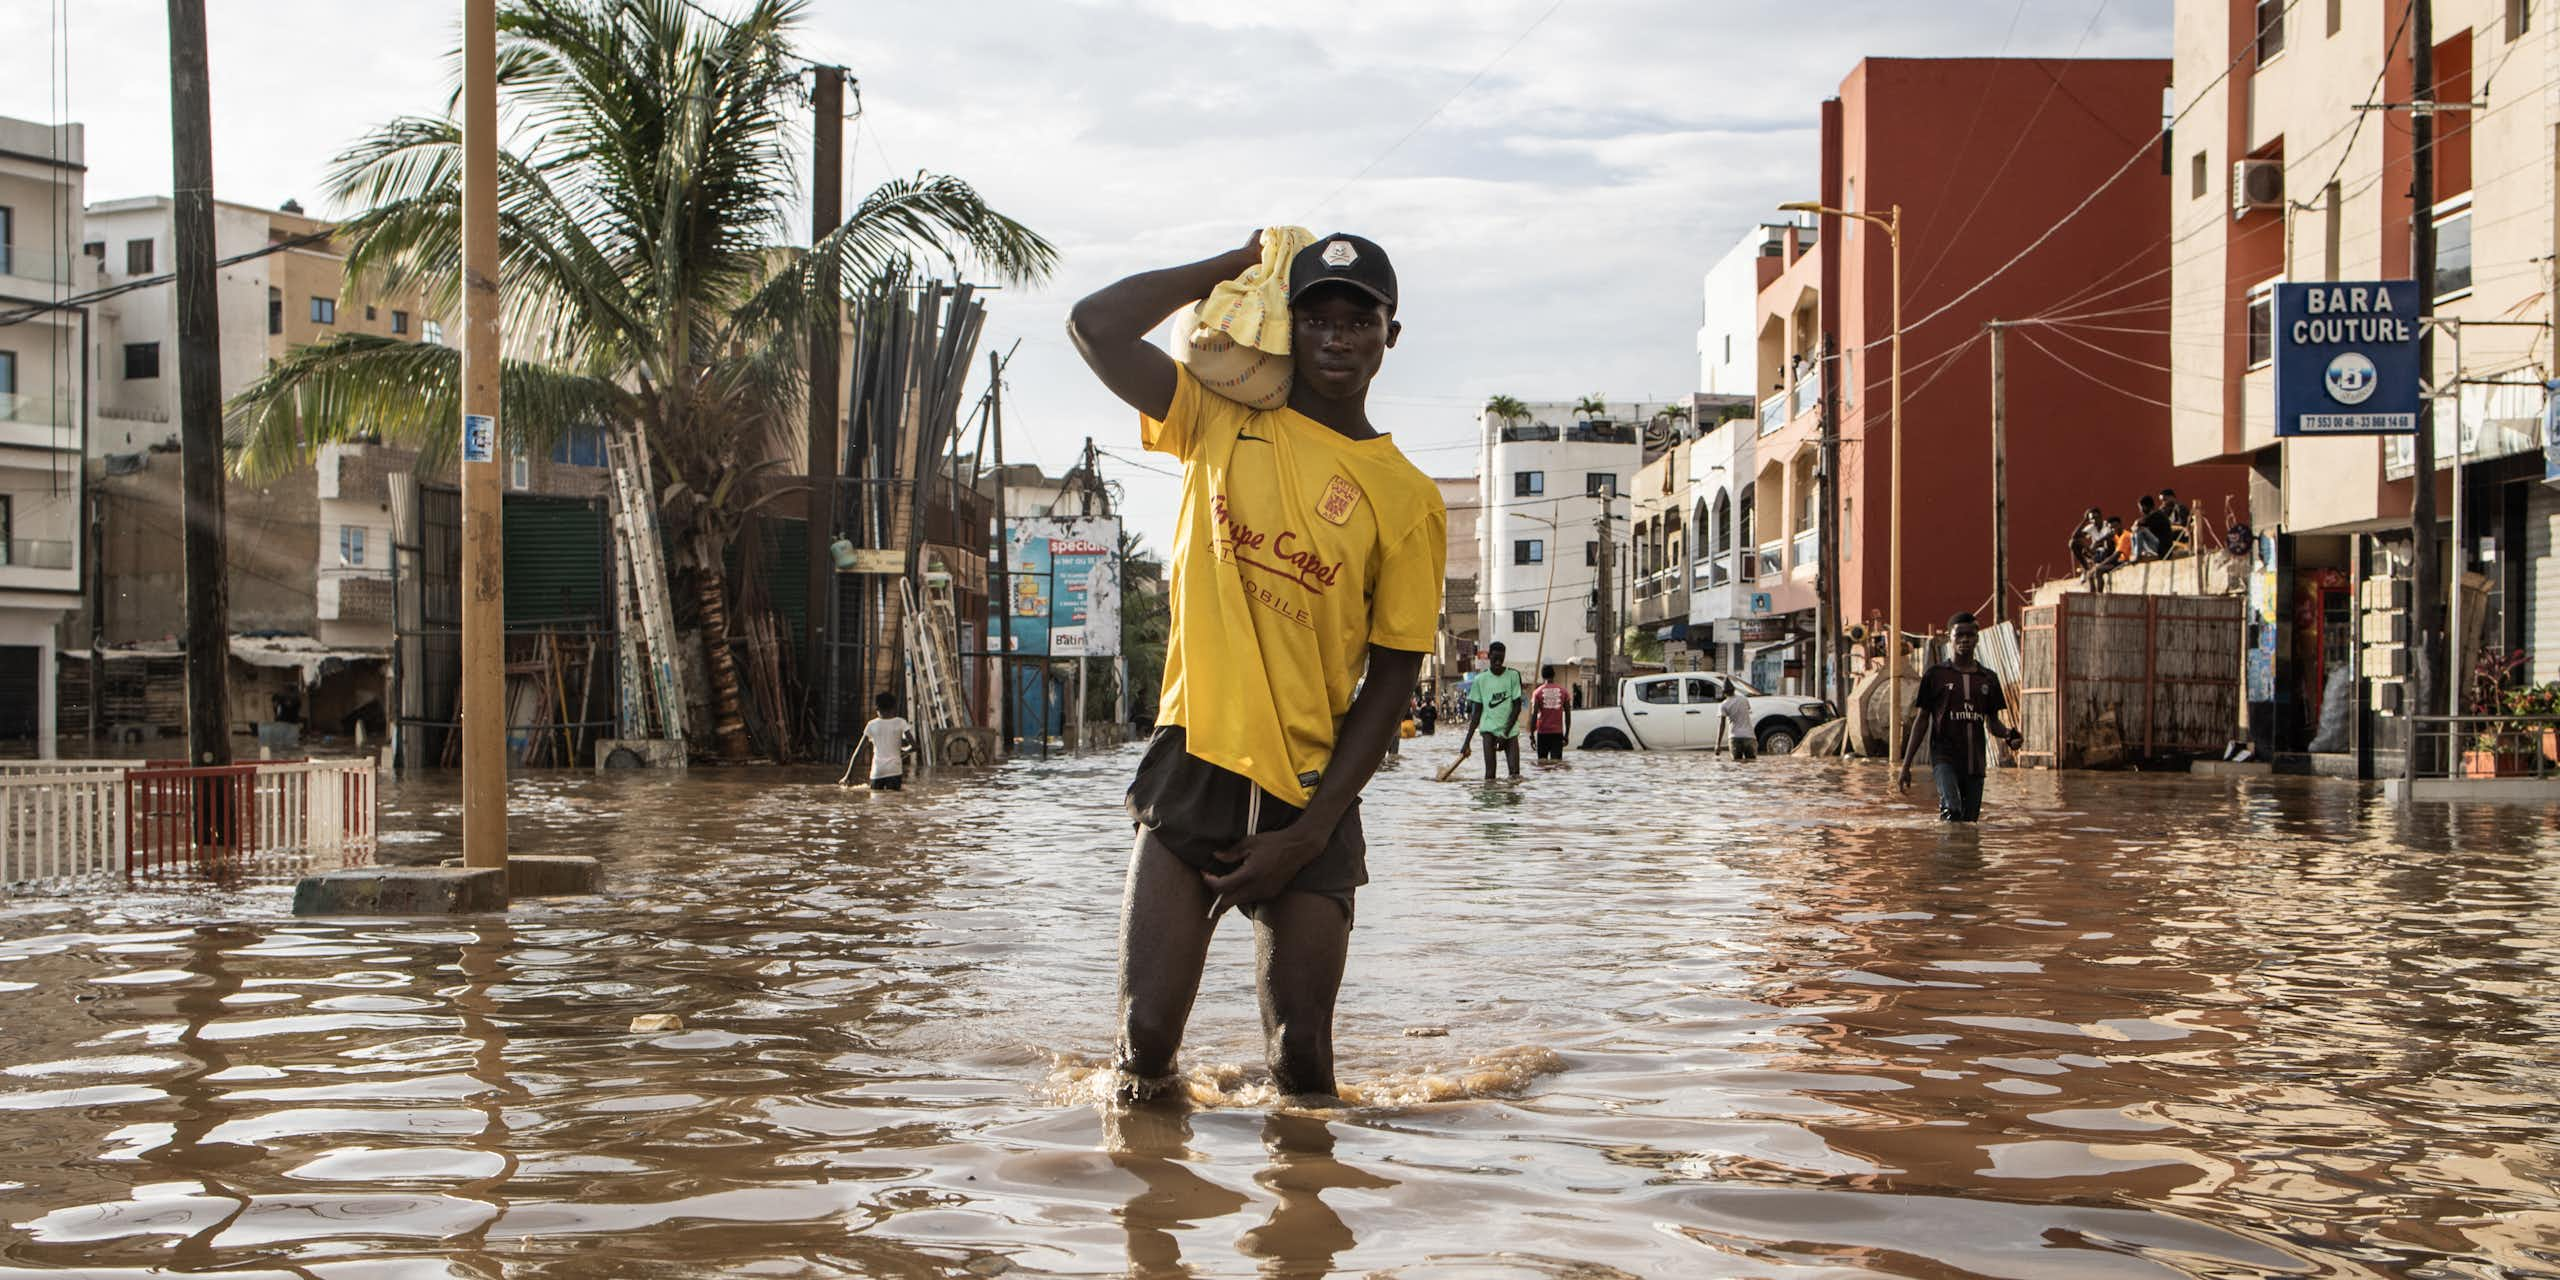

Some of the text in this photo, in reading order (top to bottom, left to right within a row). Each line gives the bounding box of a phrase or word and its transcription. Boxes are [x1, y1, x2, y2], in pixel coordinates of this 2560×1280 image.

[2308, 287, 2393, 314] BARA
[2293, 318, 2410, 345] COUTURE
[2306, 416, 2316, 428] 77
[2387, 415, 2397, 427] 14
[1273, 531, 1343, 586] Capel
